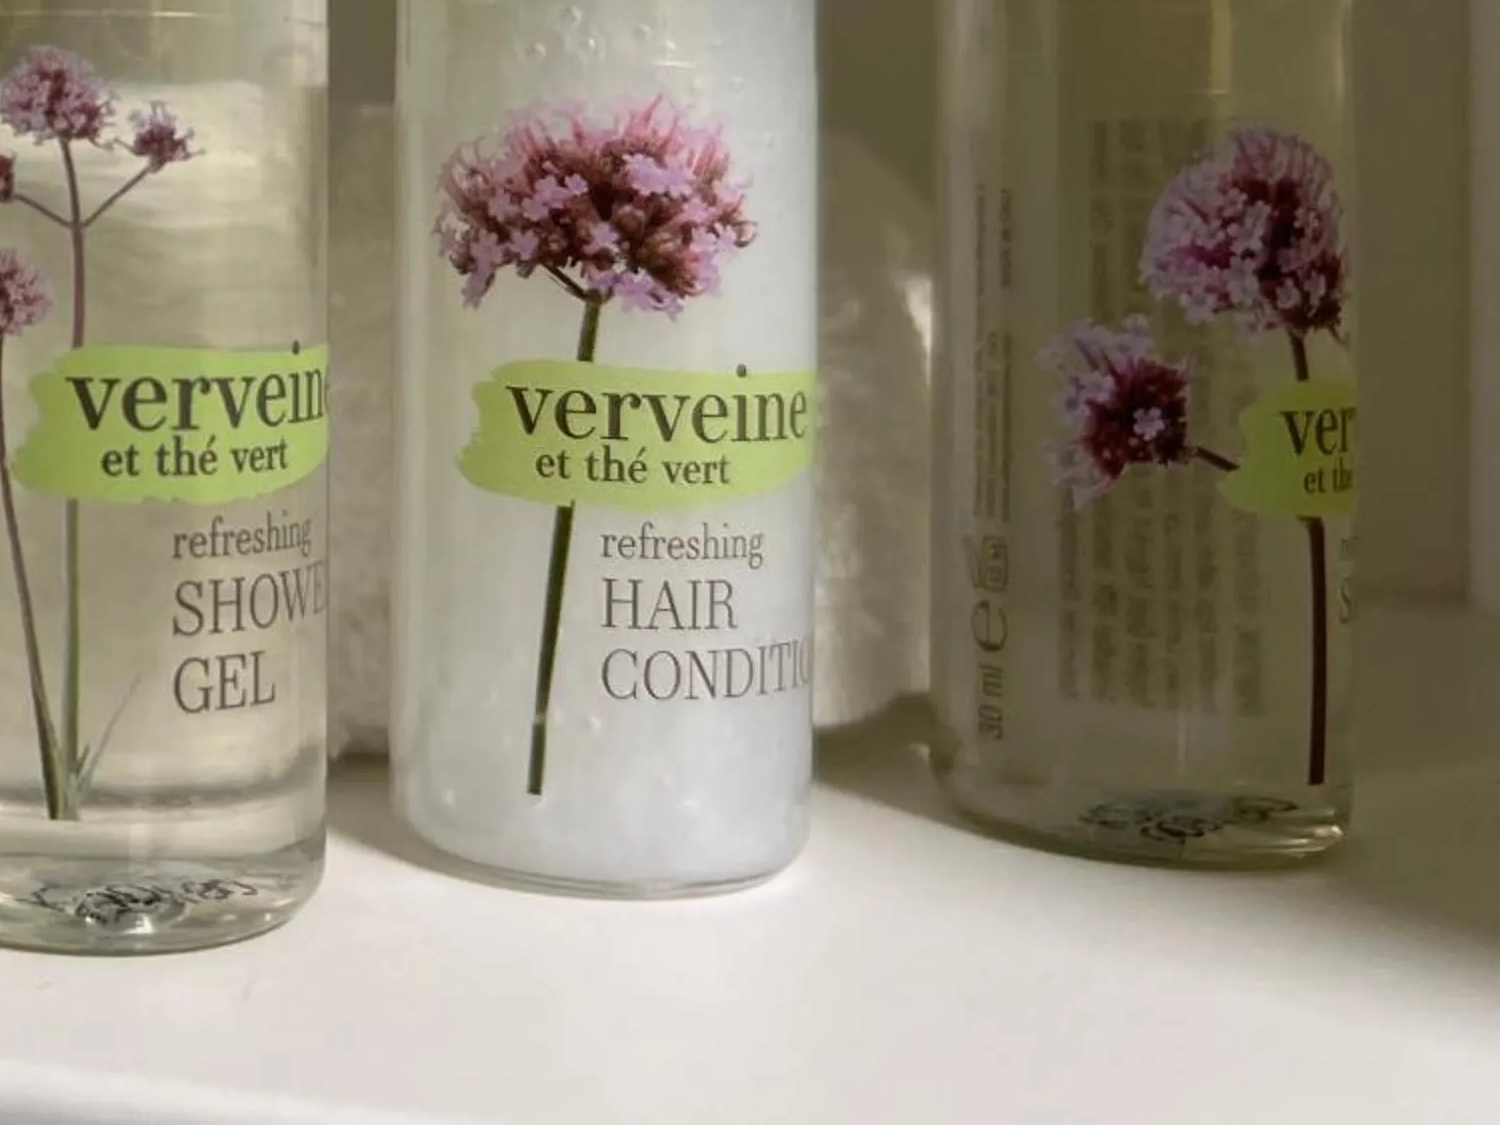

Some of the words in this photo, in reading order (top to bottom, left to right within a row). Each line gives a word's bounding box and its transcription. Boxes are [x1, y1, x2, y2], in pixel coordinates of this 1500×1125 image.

[505, 364, 809, 444] verveine
[100, 444, 140, 477] et
[155, 435, 219, 477] thé
[231, 438, 289, 473] vert
[535, 449, 571, 481] et
[585, 444, 648, 485] thé
[661, 453, 731, 485] vert
[1303, 466, 1327, 494] et
[172, 510, 313, 560] refreshing
[600, 521, 765, 570] refreshing
[600, 577, 739, 631] HAIR
[173, 650, 277, 715] GEL
